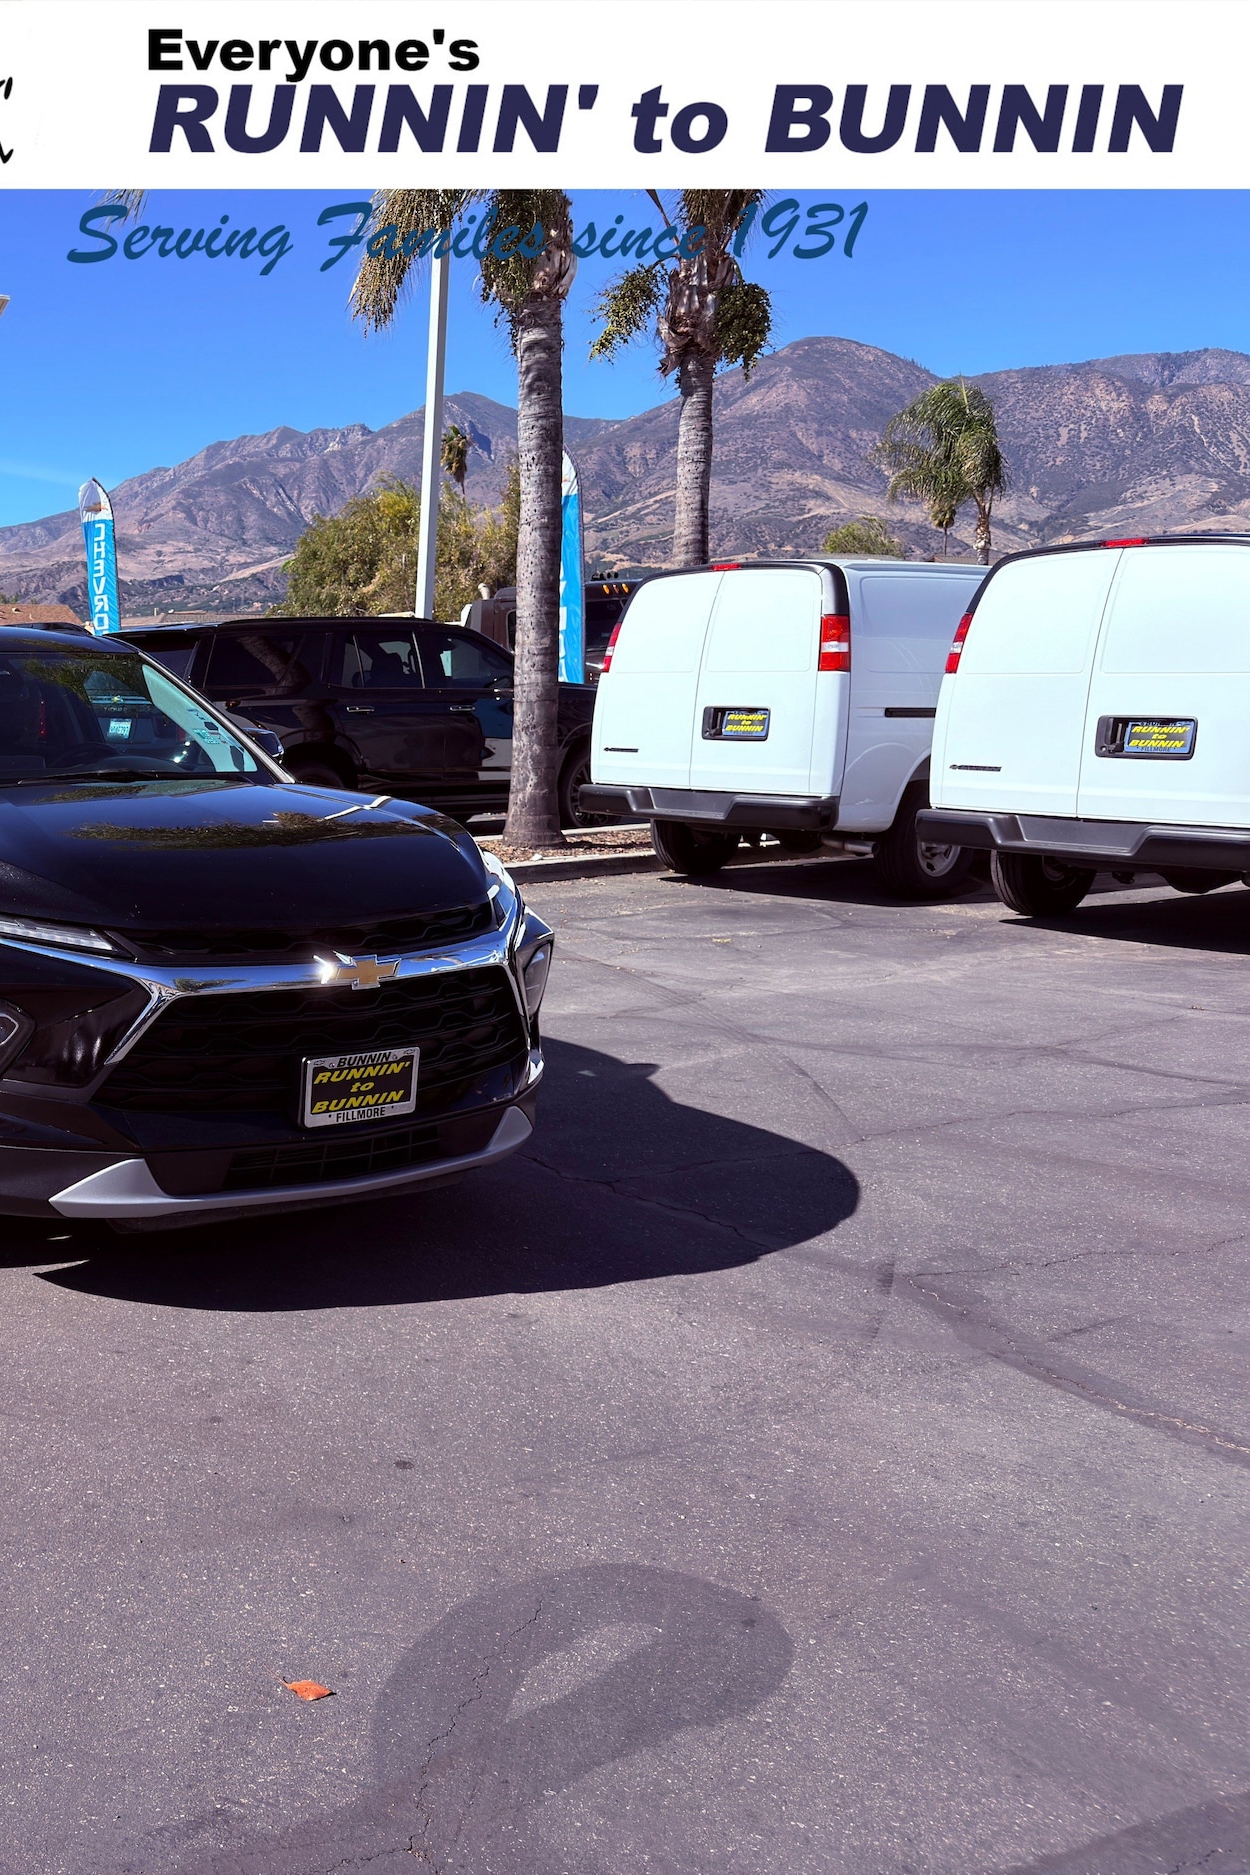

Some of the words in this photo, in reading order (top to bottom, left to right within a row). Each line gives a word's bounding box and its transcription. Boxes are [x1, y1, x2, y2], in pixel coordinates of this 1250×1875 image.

[337, 1052, 392, 1068] BUNNIN
[313, 1061, 411, 1085] RUNNIN'
[350, 1082, 375, 1093] to
[311, 1089, 405, 1114] BUNNIN
[336, 1106, 387, 1123] FILLMORE
